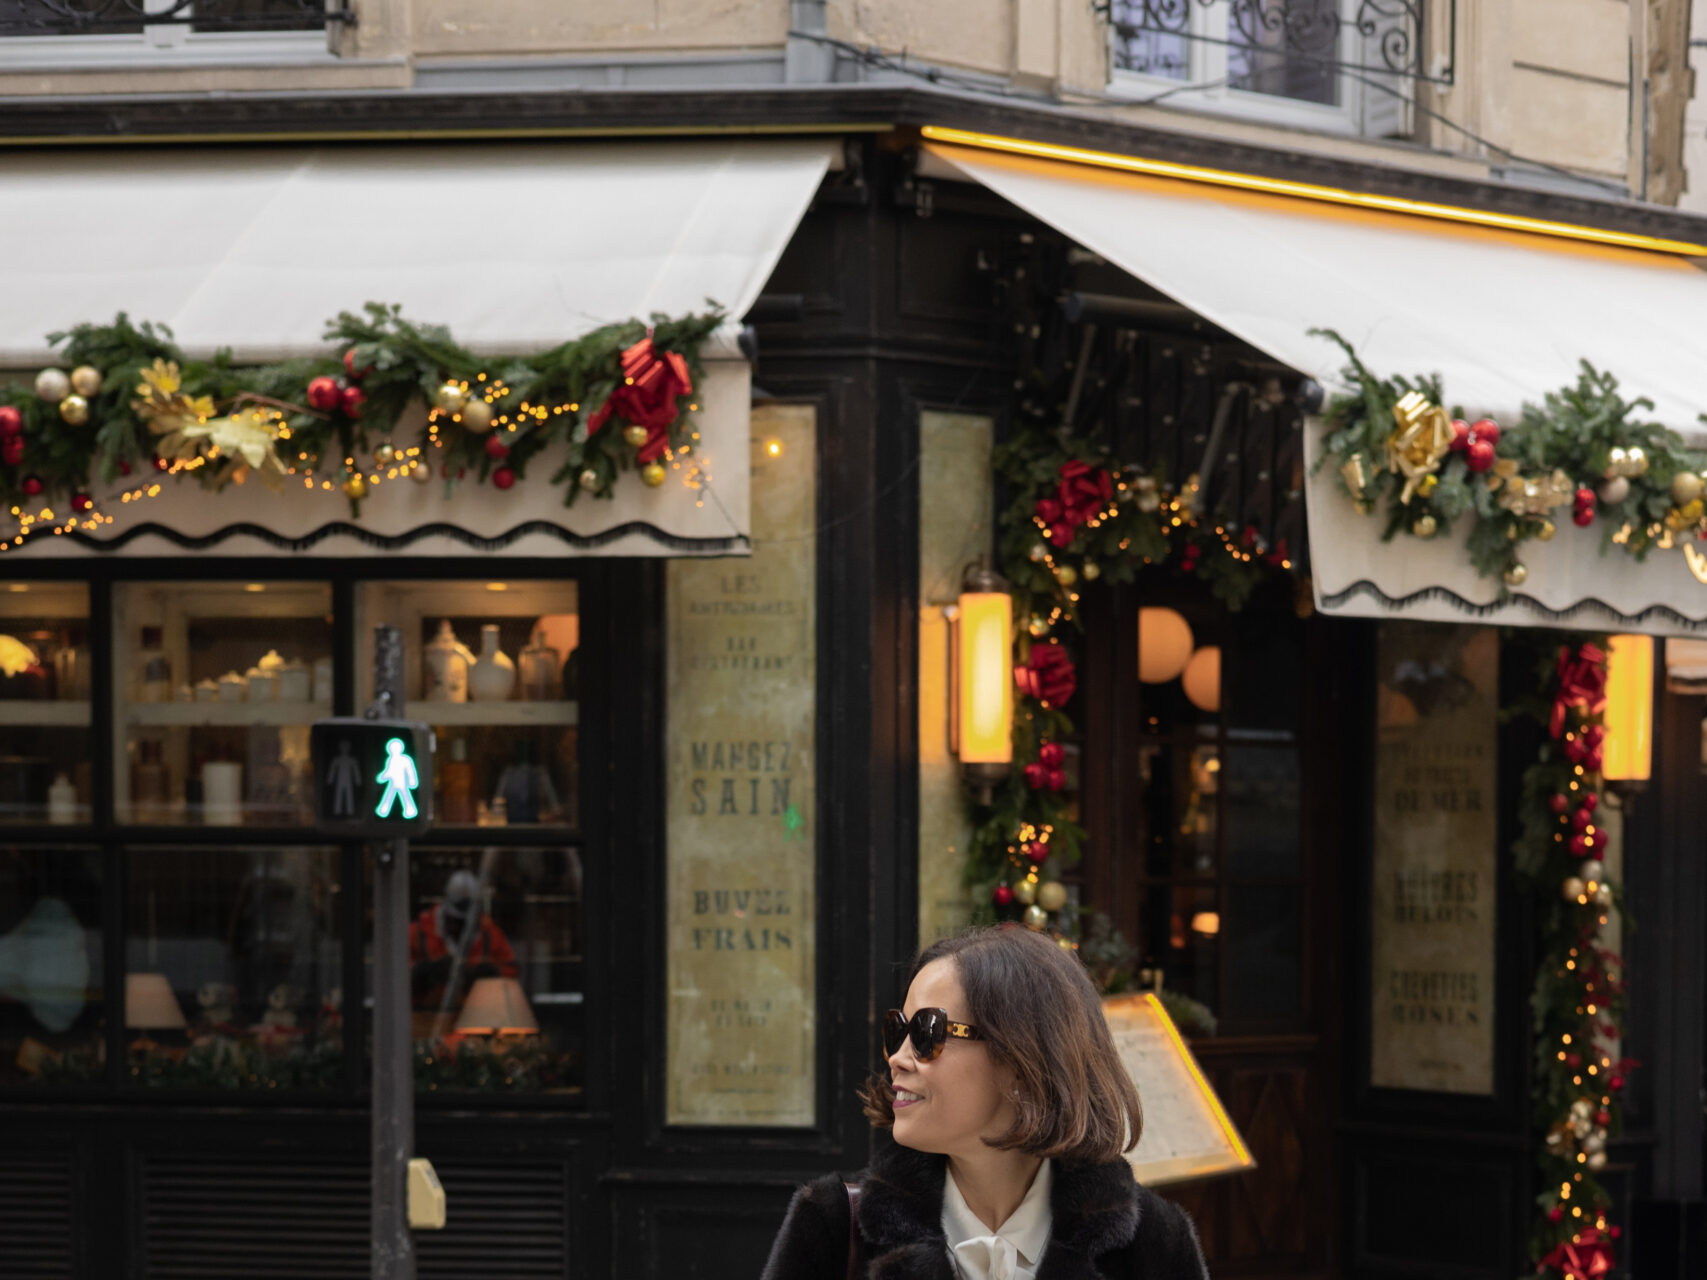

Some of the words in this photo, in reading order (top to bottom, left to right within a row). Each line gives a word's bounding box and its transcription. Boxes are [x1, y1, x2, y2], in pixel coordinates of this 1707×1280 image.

[721, 574, 761, 595] LES
[691, 741, 792, 772] MANGEZ
[691, 778, 793, 816] SAIN
[694, 889, 791, 916] BUVEZ
[692, 928, 792, 951] FRAIS
